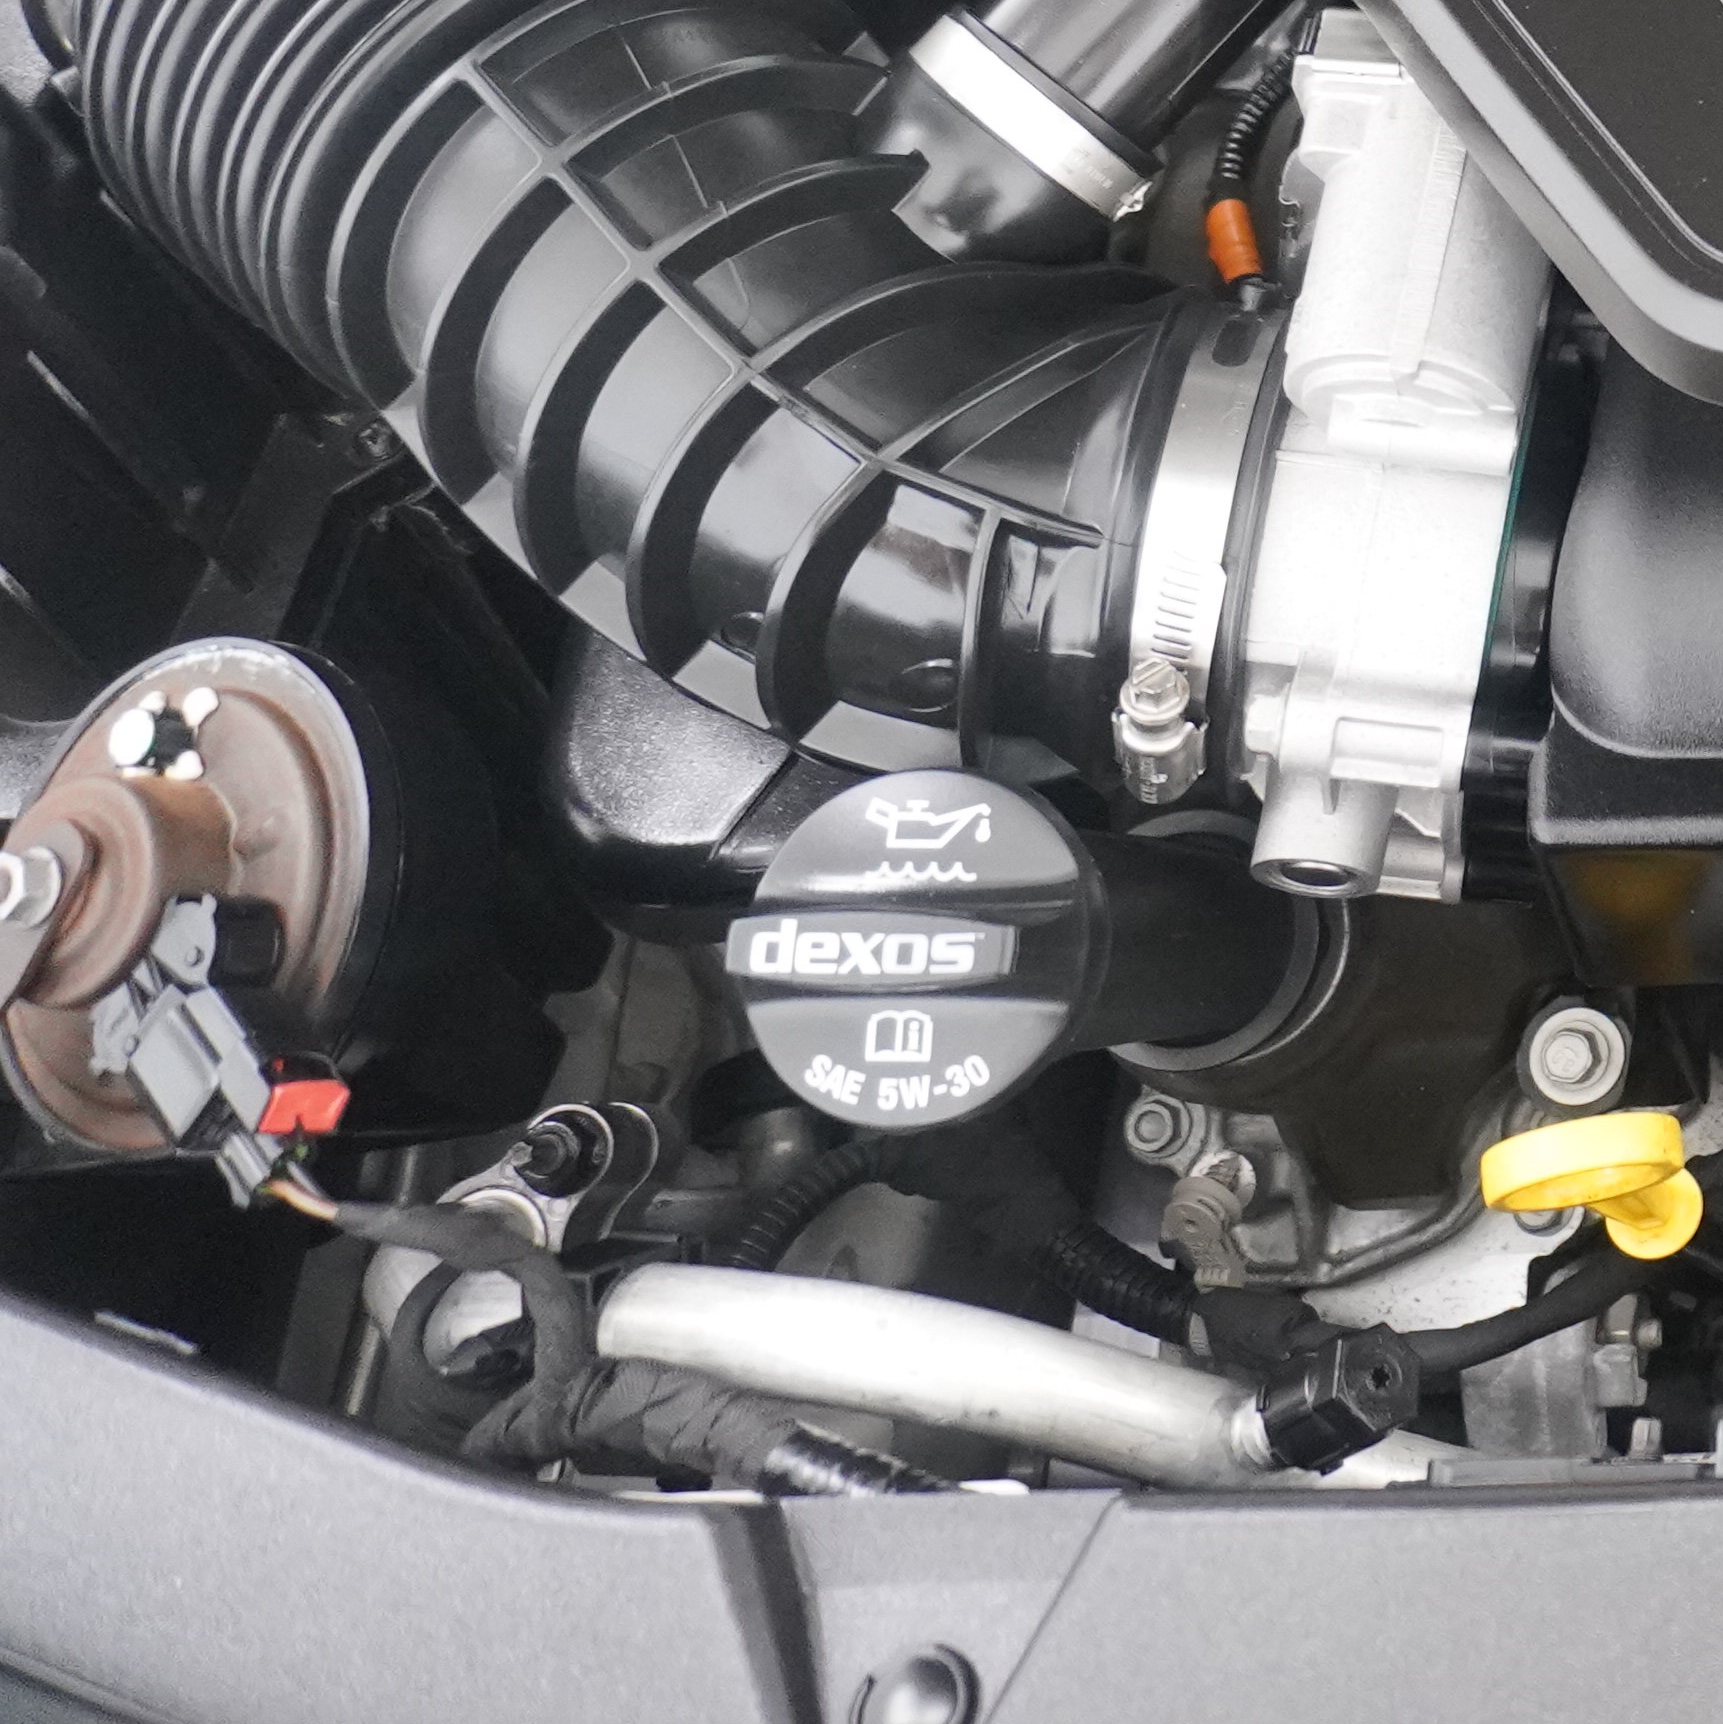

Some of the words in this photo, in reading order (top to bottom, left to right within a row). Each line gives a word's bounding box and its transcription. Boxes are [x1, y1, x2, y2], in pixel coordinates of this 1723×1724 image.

[749, 919, 976, 976] dexos
[804, 1055, 867, 1105] SAE
[877, 1054, 991, 1111] 5W-30
